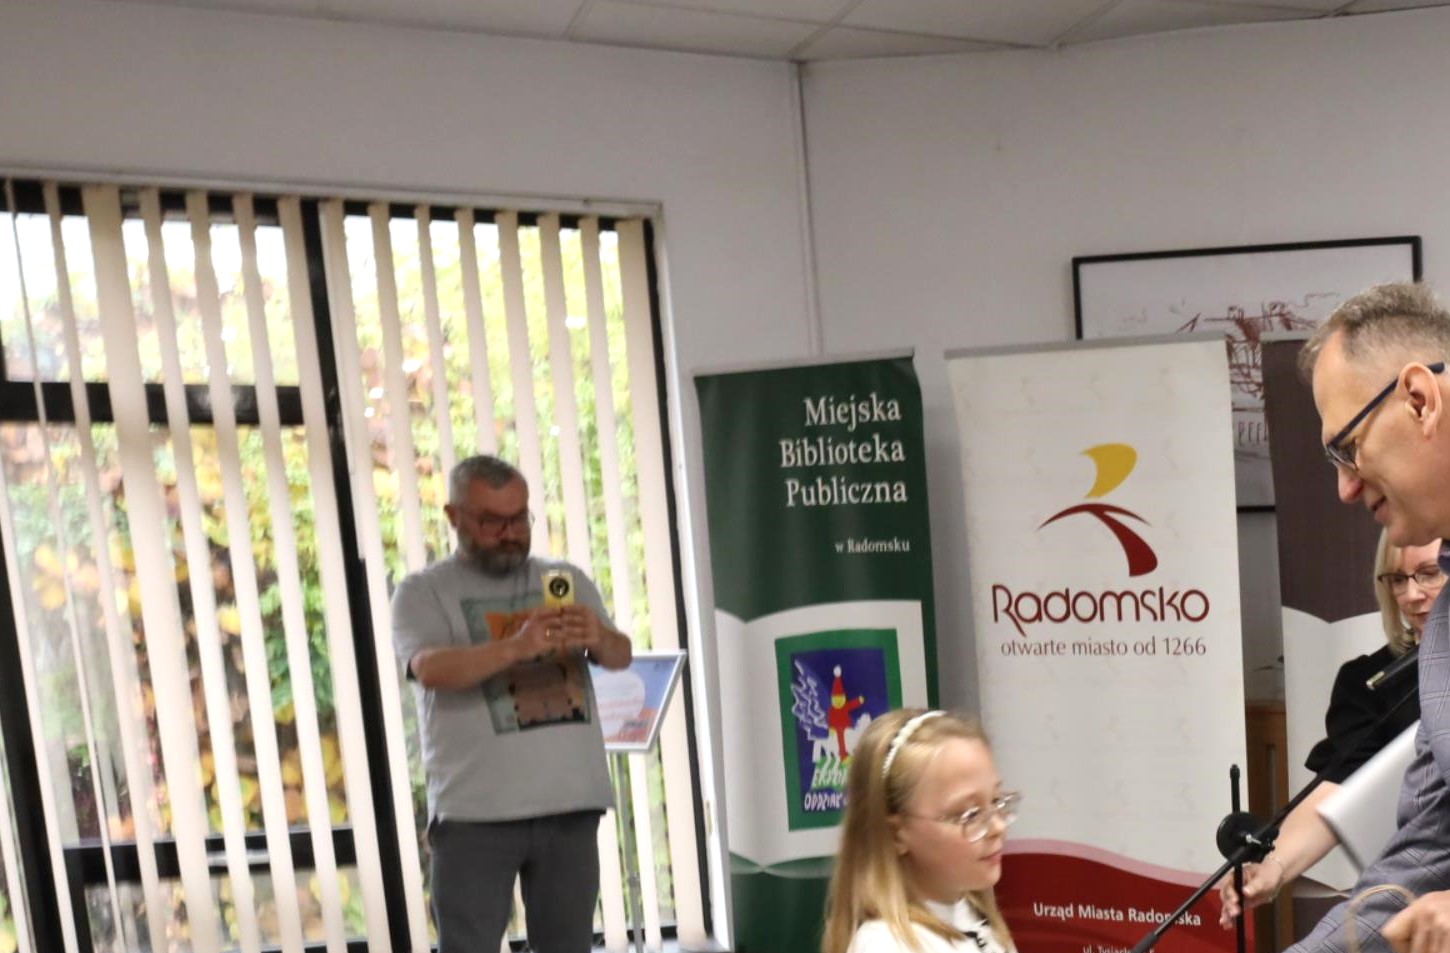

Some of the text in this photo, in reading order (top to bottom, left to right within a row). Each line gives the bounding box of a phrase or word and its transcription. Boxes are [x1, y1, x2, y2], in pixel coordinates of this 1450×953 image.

[804, 392, 902, 432] Miejska
[779, 433, 906, 468] Biblioteka
[785, 476, 908, 507] Publiczna
[835, 537, 910, 553] w Radomsku
[992, 584, 1210, 637] Radomsko
[1000, 635, 1207, 656] otwarte miasto od 1266
[1033, 902, 1074, 920] Urząd
[1078, 904, 1124, 921] Miasta
